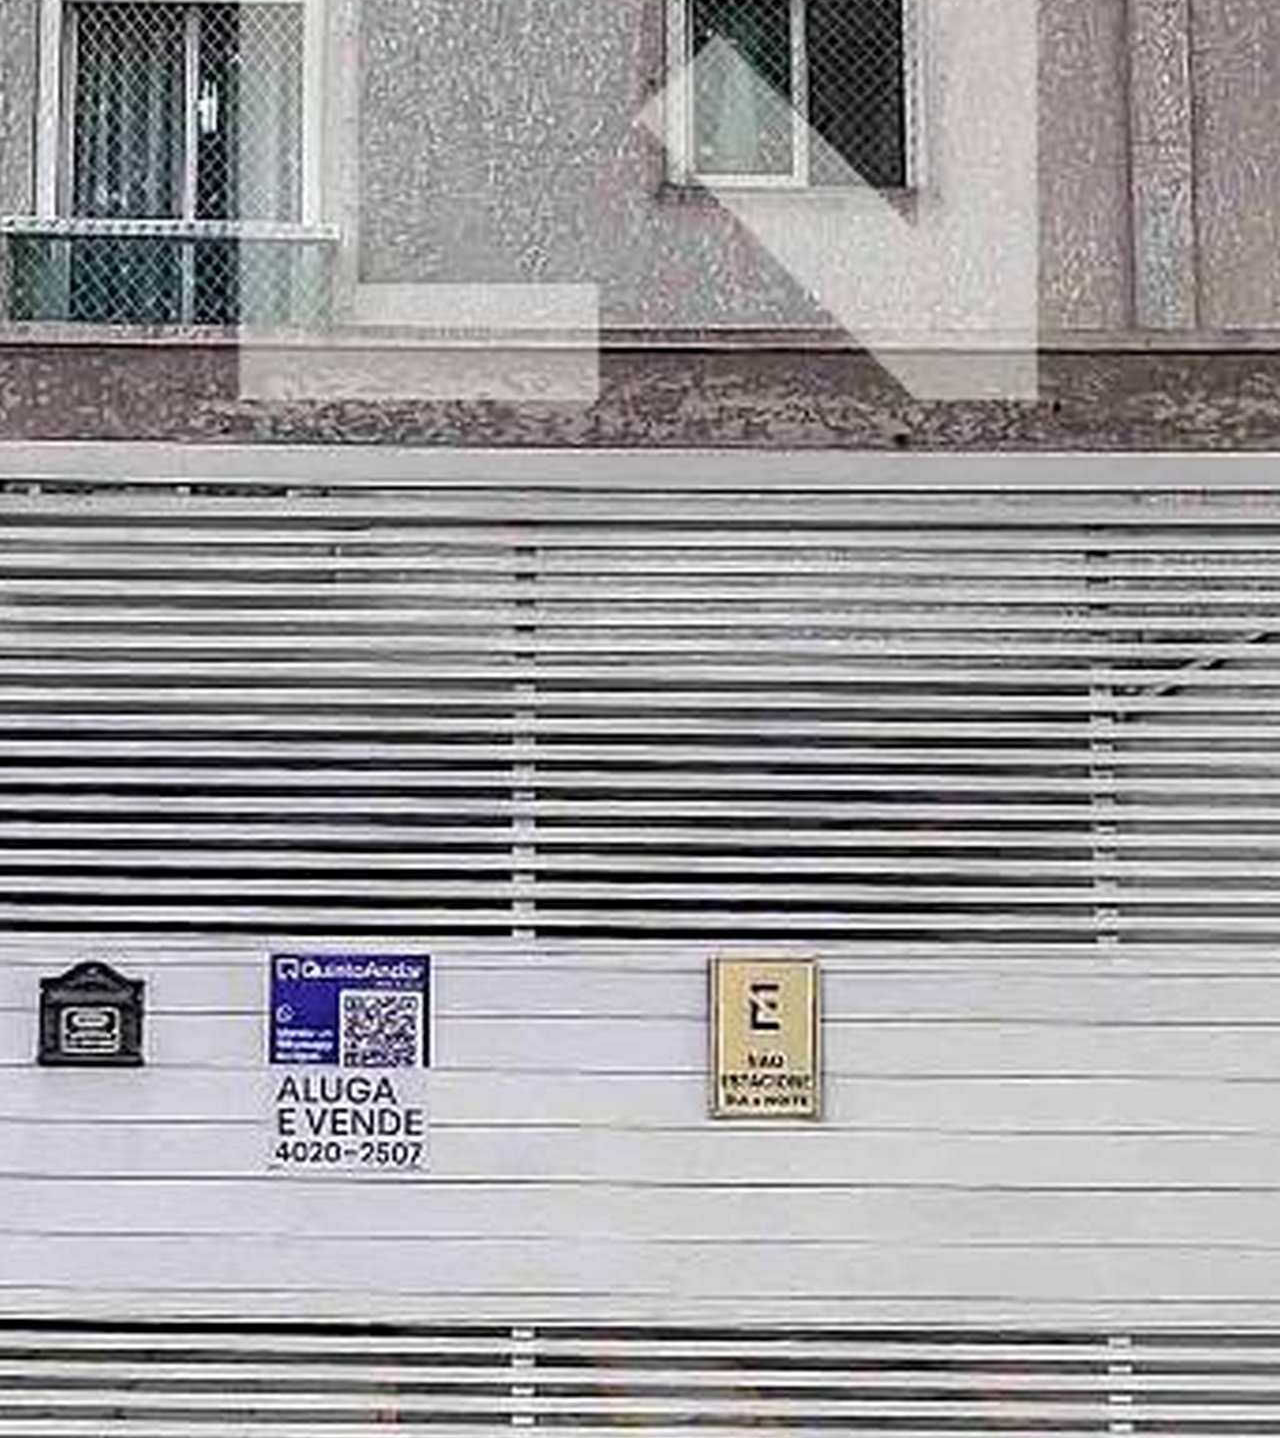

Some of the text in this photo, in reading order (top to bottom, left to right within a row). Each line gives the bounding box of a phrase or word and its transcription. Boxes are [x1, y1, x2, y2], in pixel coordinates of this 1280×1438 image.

[276, 1075, 398, 1105] ALUGA
[278, 1107, 423, 1136] E VENDE
[275, 1140, 423, 1166] 4020-2507
